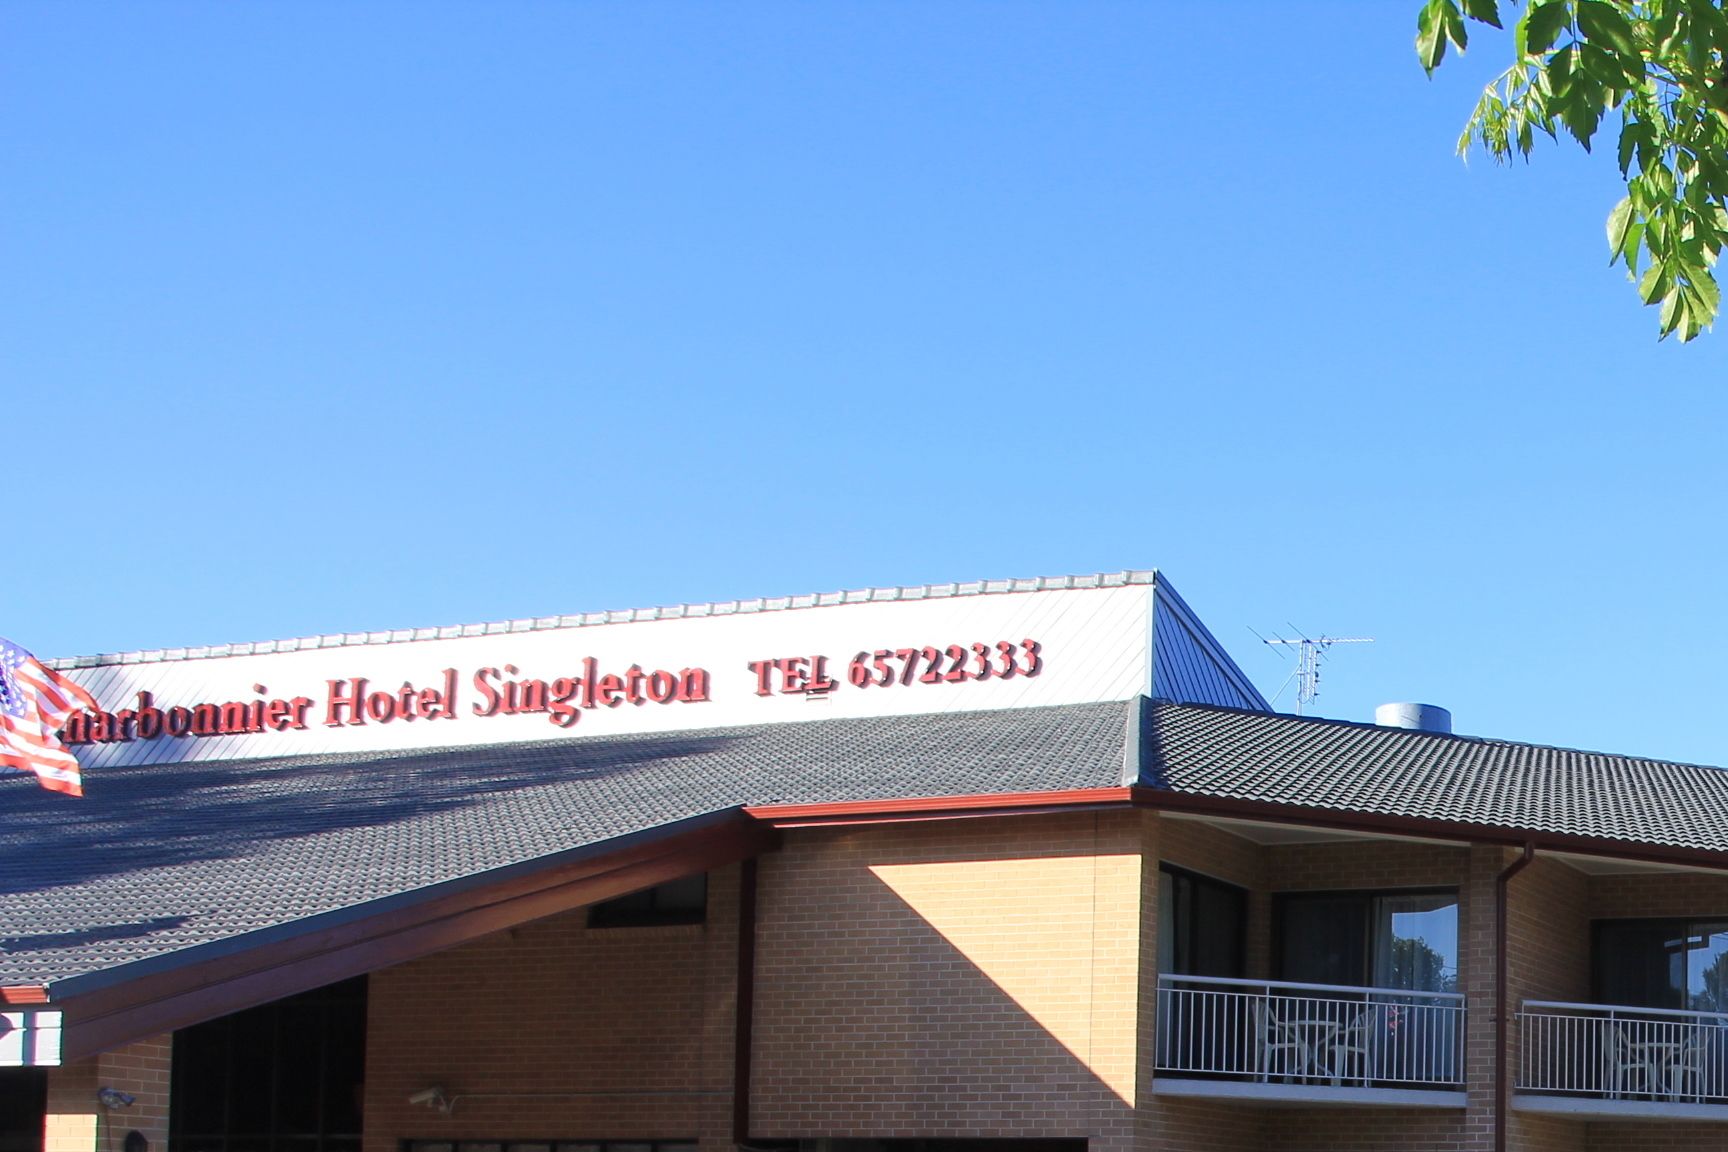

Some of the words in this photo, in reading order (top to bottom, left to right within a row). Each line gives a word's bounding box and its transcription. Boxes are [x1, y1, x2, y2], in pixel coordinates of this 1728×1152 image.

[323, 668, 458, 727] Hotel
[472, 656, 712, 728] Singleton
[748, 655, 839, 696] TEL
[848, 639, 1043, 689] 65722333
